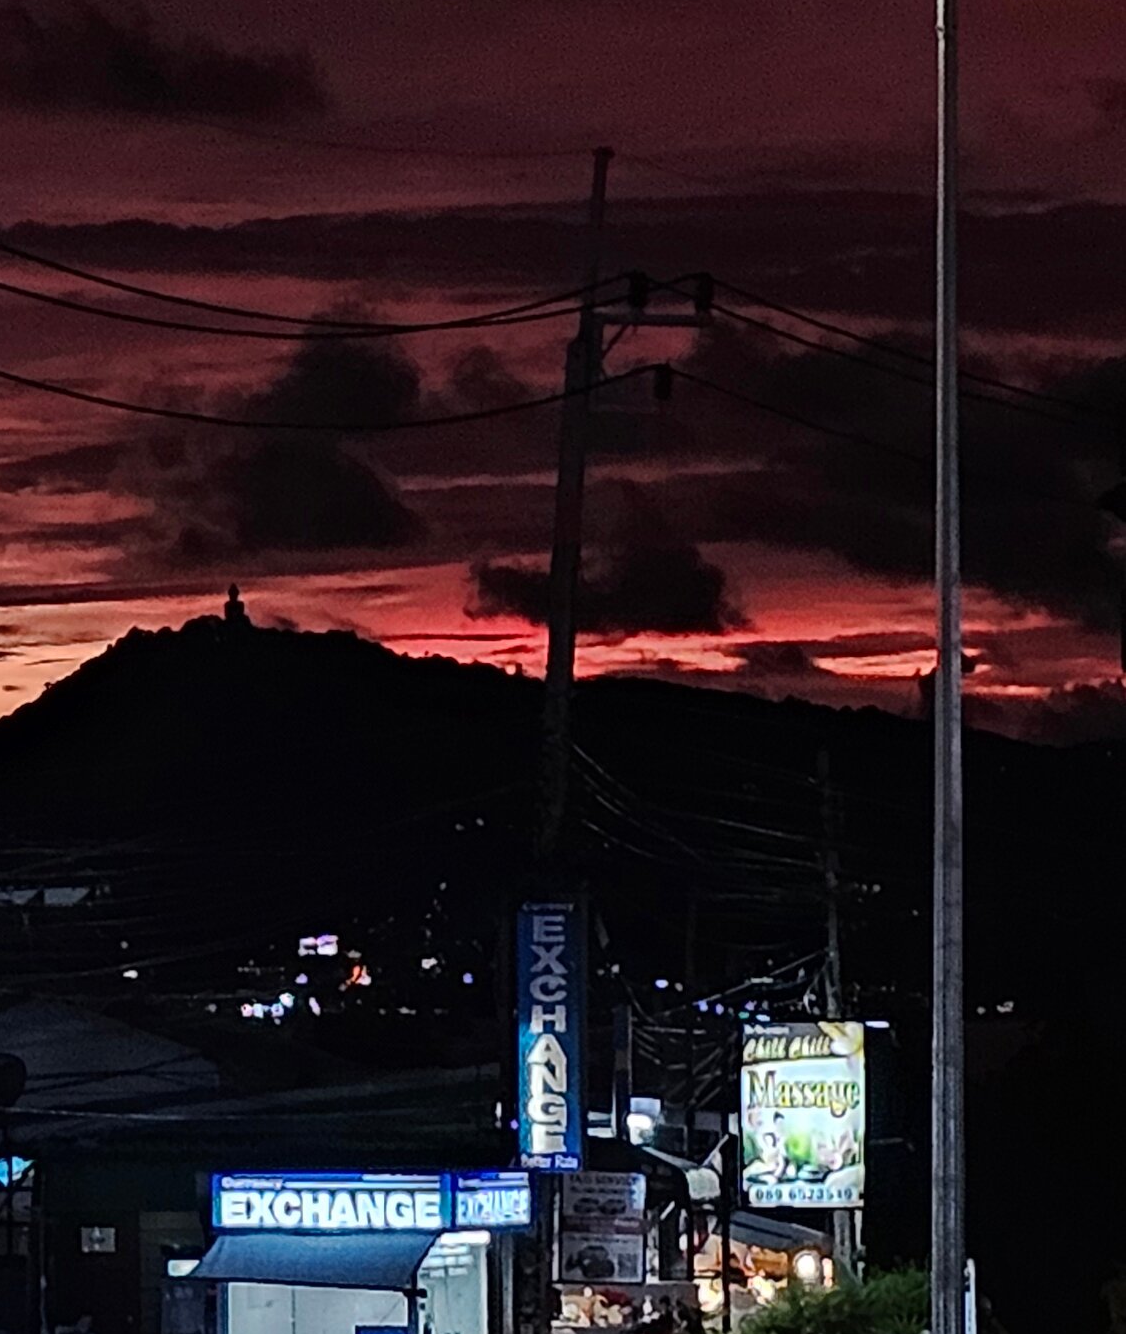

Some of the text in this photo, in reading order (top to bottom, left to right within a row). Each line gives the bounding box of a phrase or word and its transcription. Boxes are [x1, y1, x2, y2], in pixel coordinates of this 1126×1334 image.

[527, 915, 568, 1155] EXCHANGE
[747, 1070, 860, 1118] Massage
[220, 1190, 442, 1230] EXCHANGE
[457, 1188, 531, 1227] EXCHANGE
